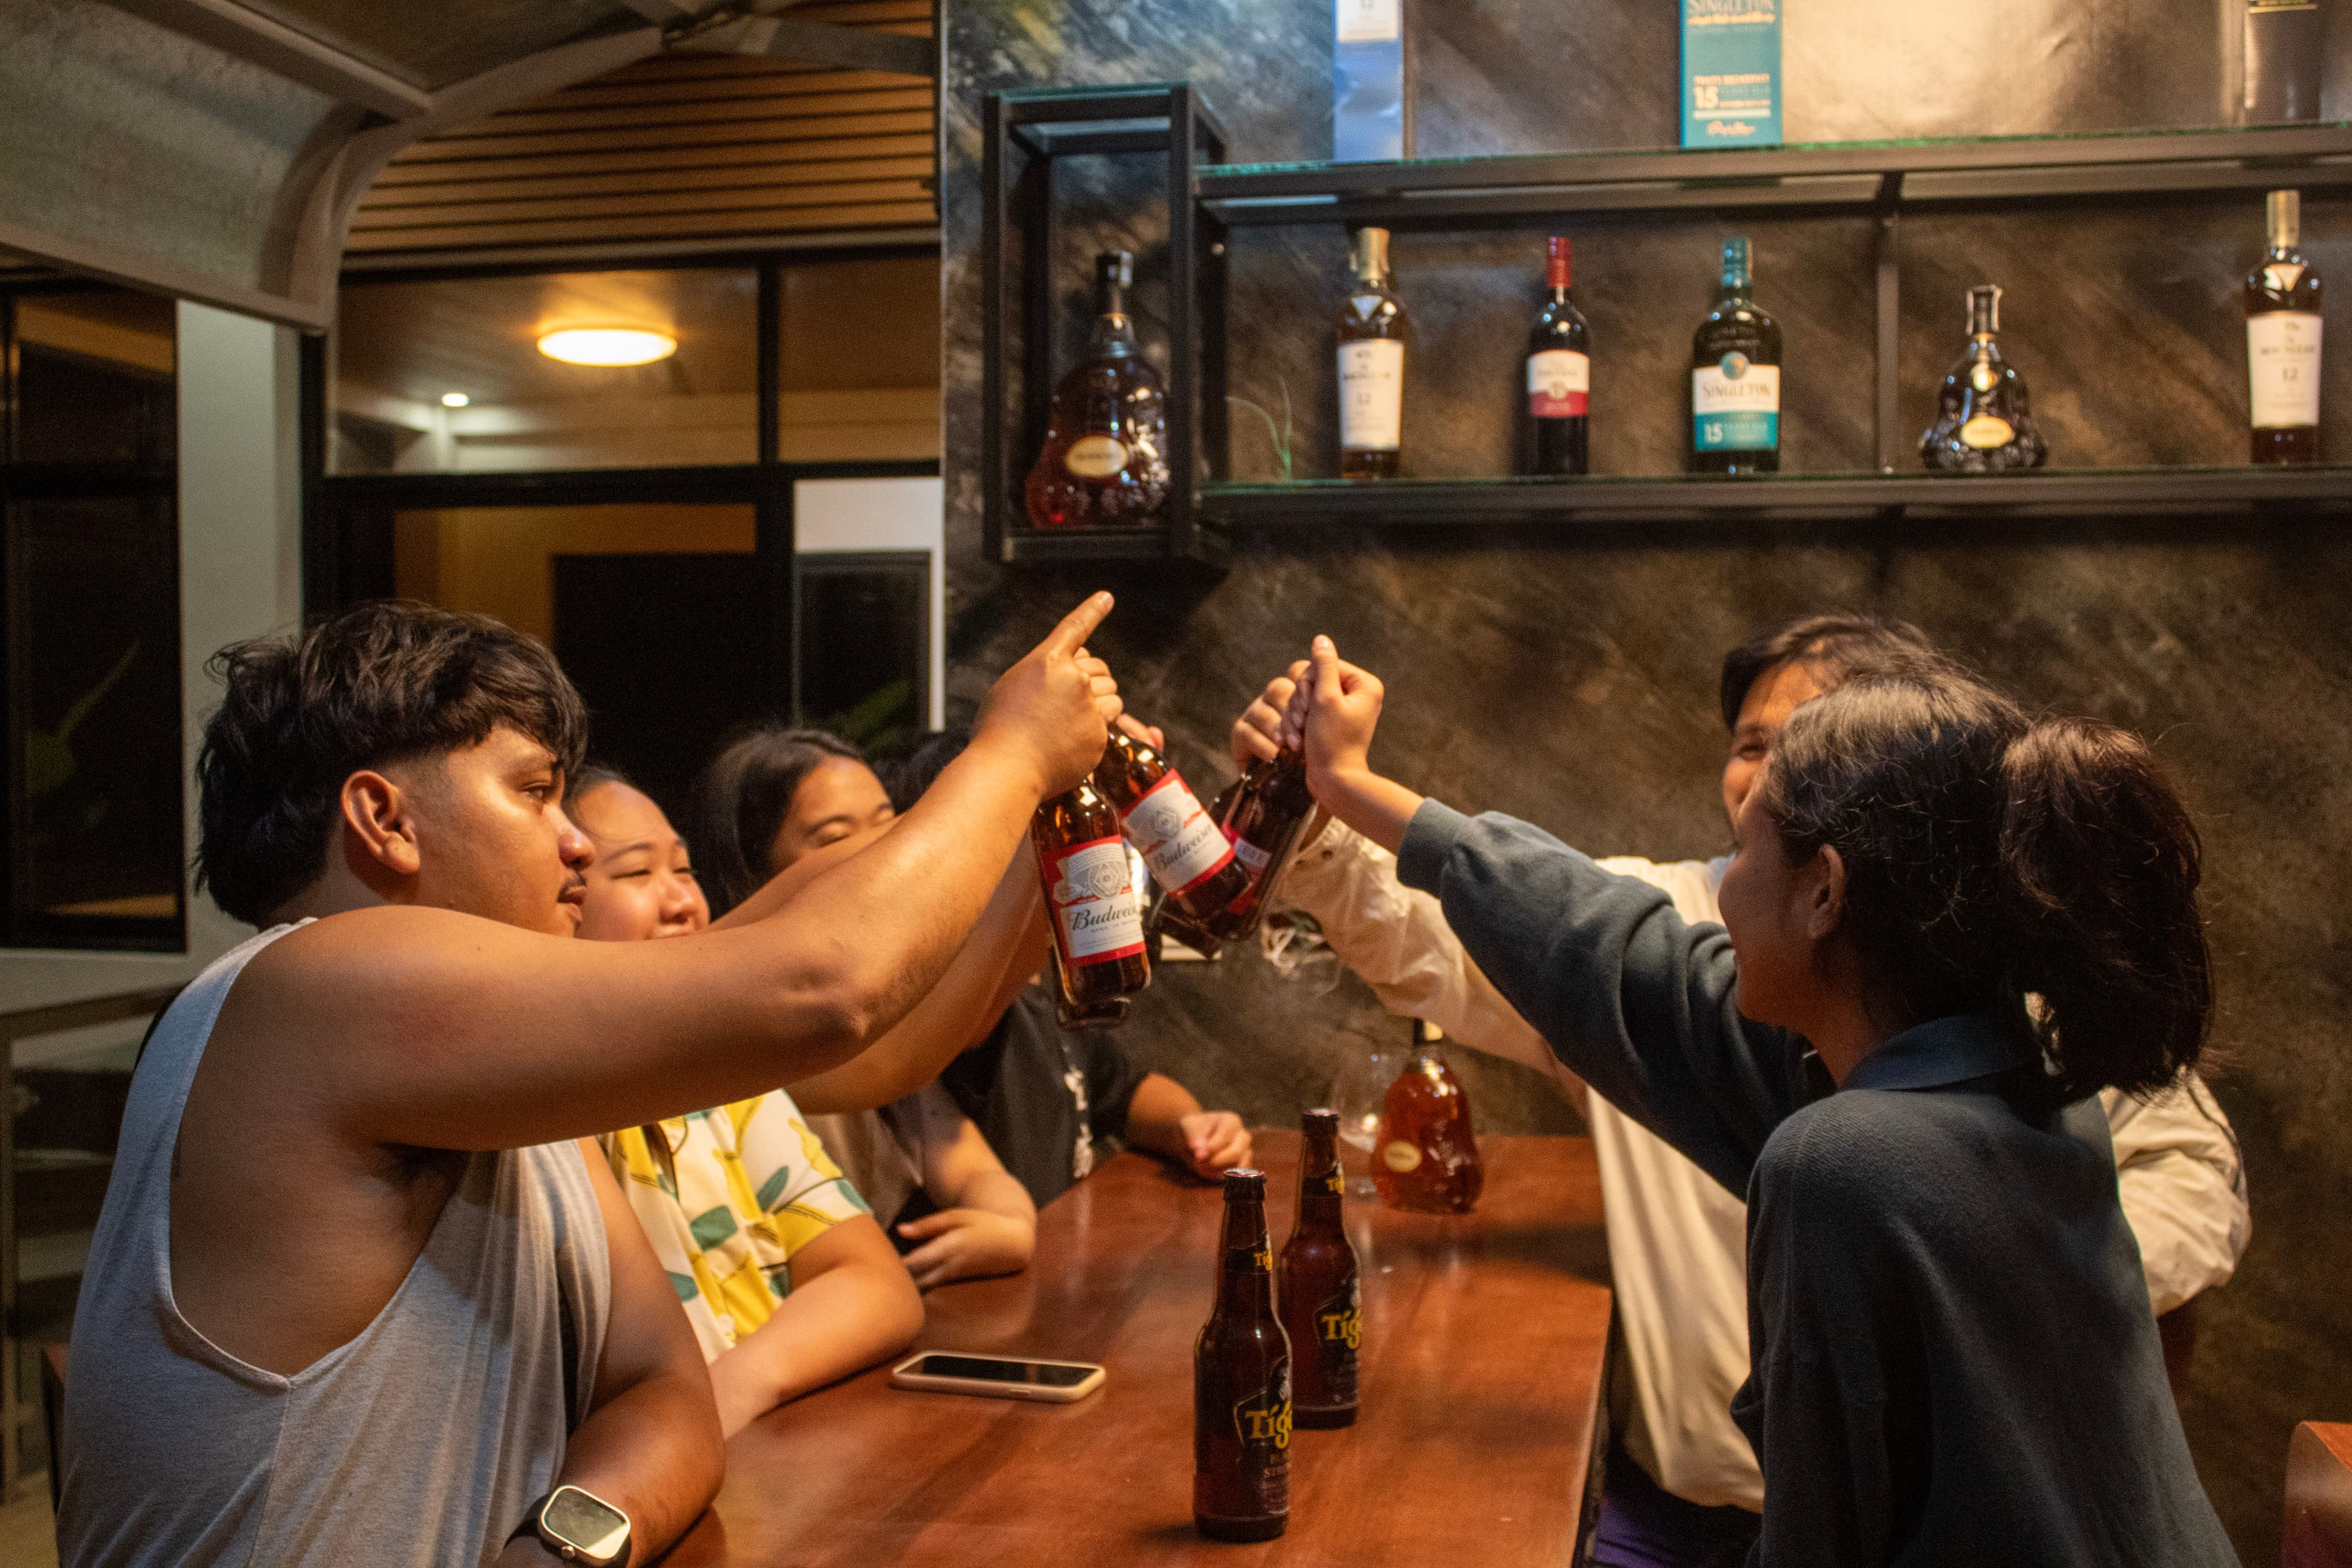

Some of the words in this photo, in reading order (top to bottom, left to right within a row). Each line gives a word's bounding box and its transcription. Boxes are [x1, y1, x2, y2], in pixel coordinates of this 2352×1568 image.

[1693, 86, 1719, 108] 15
[1702, 382, 1770, 398] SINGLETON
[1705, 423, 1723, 442] 15
[1155, 824, 1212, 870] Budweiser
[1322, 1309, 1361, 1349] Tig
[1245, 1401, 1292, 1449] Tig
